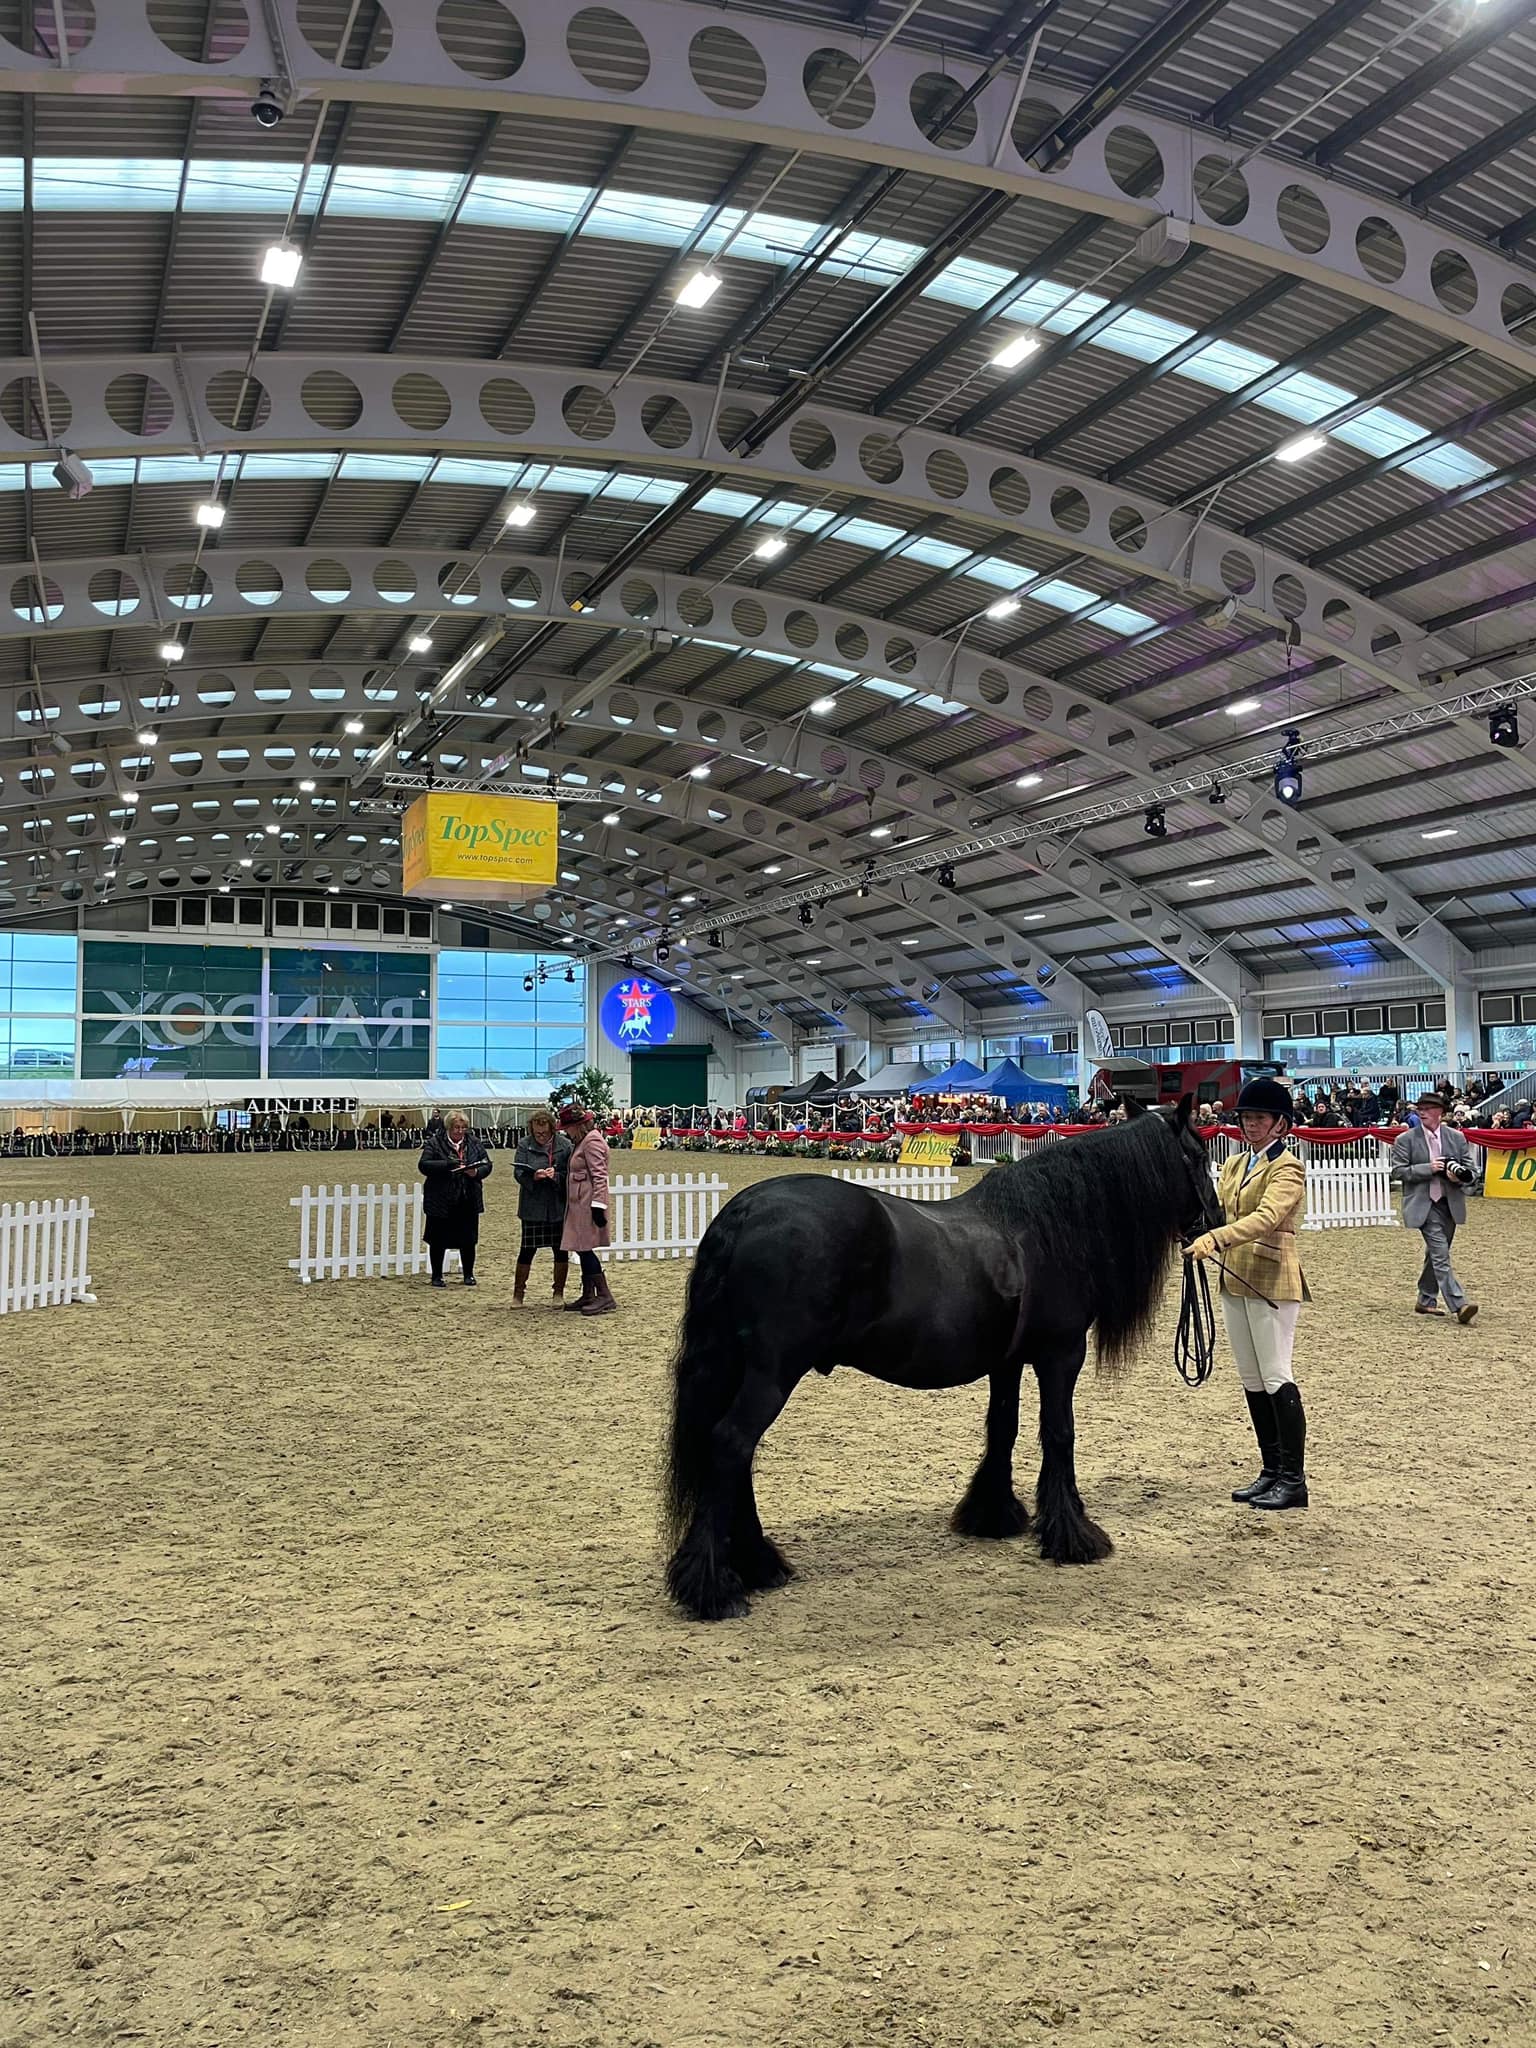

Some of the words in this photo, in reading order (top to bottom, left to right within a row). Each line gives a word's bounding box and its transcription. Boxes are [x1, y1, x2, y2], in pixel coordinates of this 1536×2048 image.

[440, 815, 549, 852] TopSpec
[457, 853, 534, 865] www.topspec.com
[621, 999, 653, 1008] STARS
[246, 1098, 356, 1114] AINTREE
[1499, 1149, 1536, 1192] To
